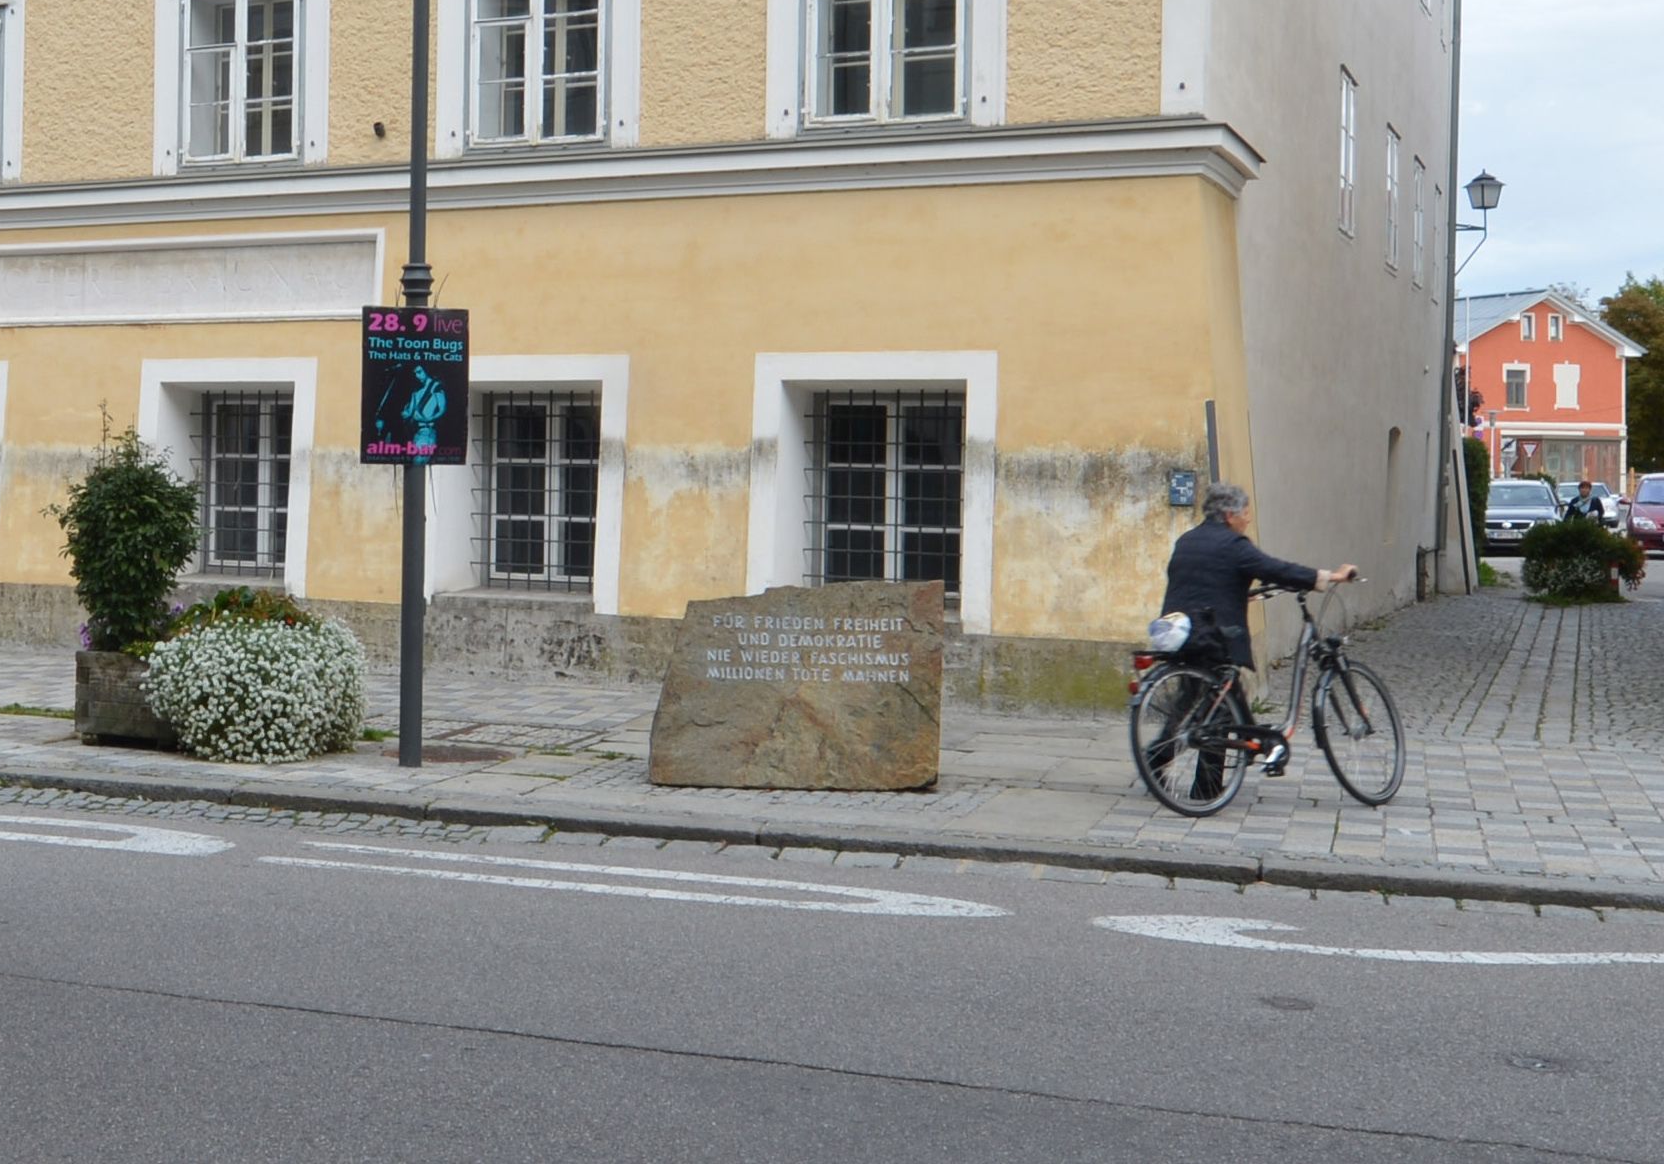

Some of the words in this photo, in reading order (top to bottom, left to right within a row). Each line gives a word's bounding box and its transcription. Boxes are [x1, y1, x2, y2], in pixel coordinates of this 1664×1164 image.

[368, 312, 406, 332] 28.
[412, 313, 428, 332] 9
[433, 314, 464, 334] live
[368, 337, 393, 349] The
[397, 338, 429, 349] Toon
[433, 338, 464, 353] Bugs
[368, 350, 387, 361] The
[388, 352, 411, 361] Hats
[413, 353, 421, 361] &
[423, 352, 441, 362] The
[442, 352, 464, 362] Cats
[713, 614, 745, 629] FÜR
[754, 616, 825, 629] FRIEDEN
[833, 617, 904, 631] FREIHEIT
[738, 633, 770, 646] UND
[778, 635, 883, 649] DEMOKRATIE
[706, 649, 732, 662] NIE
[740, 650, 801, 664] WIEDER
[810, 651, 911, 666] FASCHISMUS
[706, 667, 785, 681] MILLIONEN
[792, 667, 831, 682] TOTE
[841, 669, 910, 683] MAHNEN
